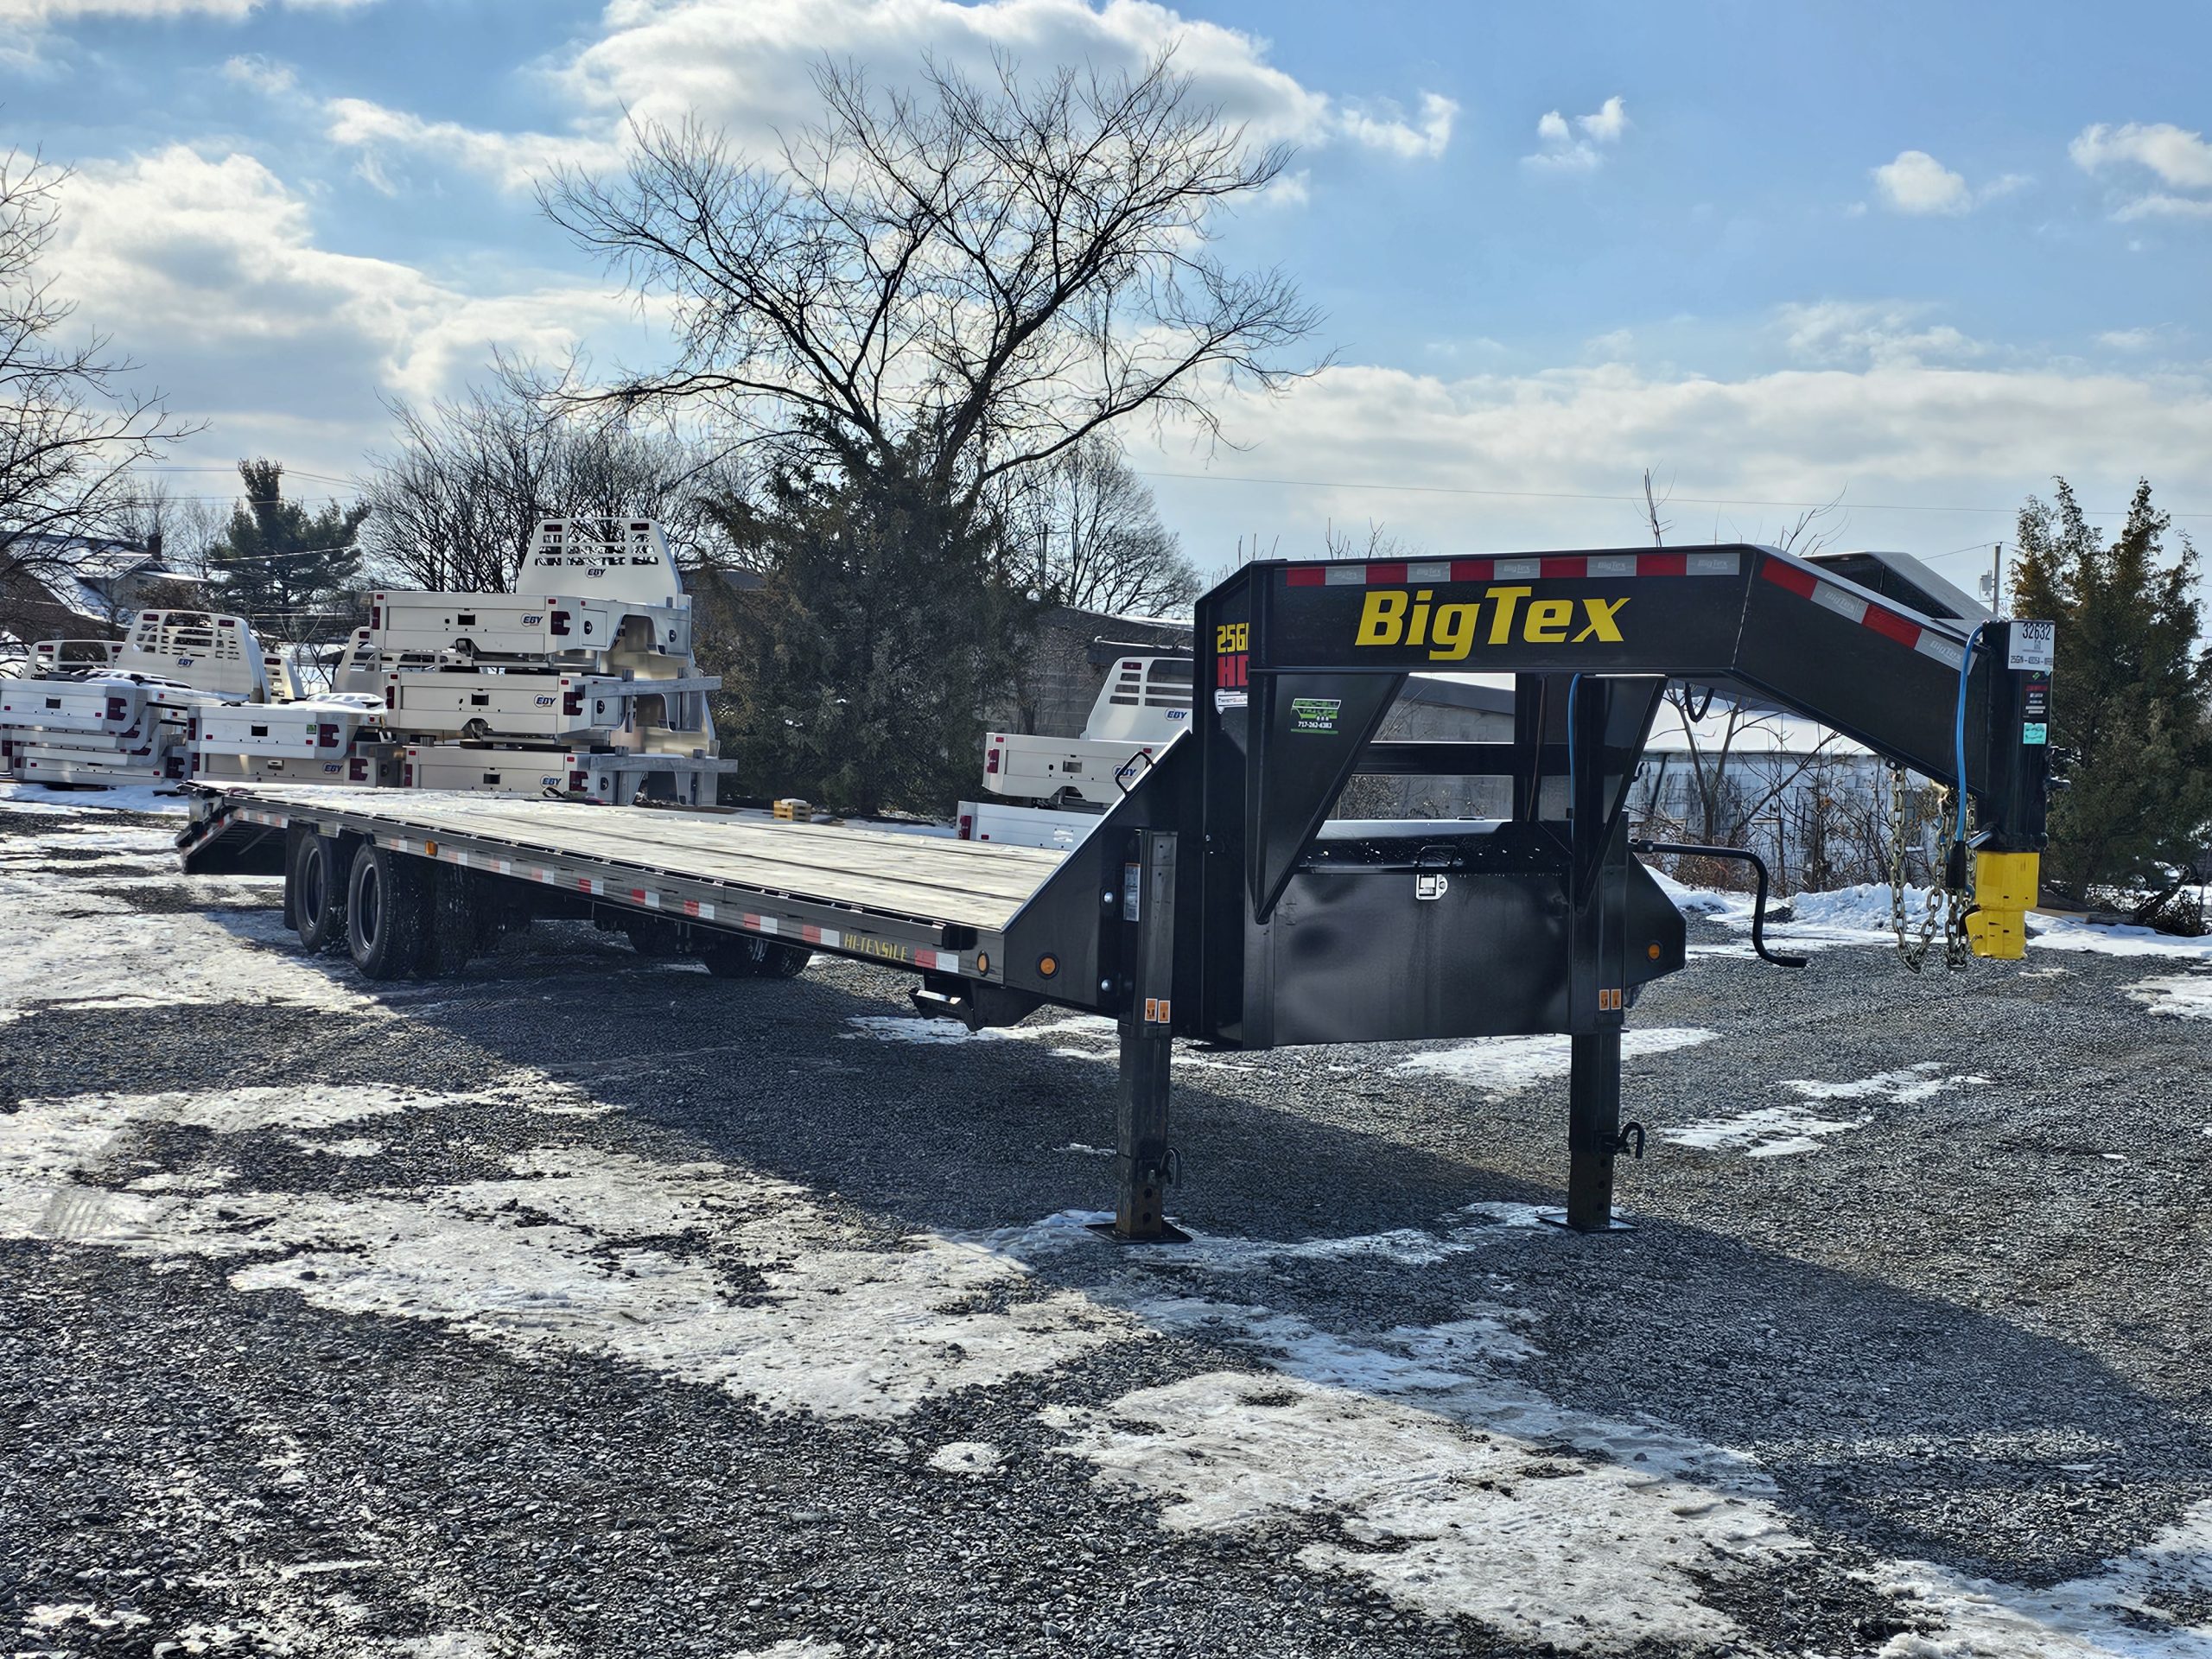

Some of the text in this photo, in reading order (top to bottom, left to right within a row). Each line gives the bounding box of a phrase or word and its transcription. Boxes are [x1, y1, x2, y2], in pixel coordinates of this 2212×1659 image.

[588, 568, 607, 576] EBY
[1355, 587, 1631, 661] BigTex
[2023, 622, 2051, 640] 32632
[537, 696, 556, 705] EBY
[1166, 710, 1188, 719] EBY
[325, 764, 344, 772] EBY
[543, 777, 562, 785] EBY
[844, 932, 908, 961] HI-TENSILE
